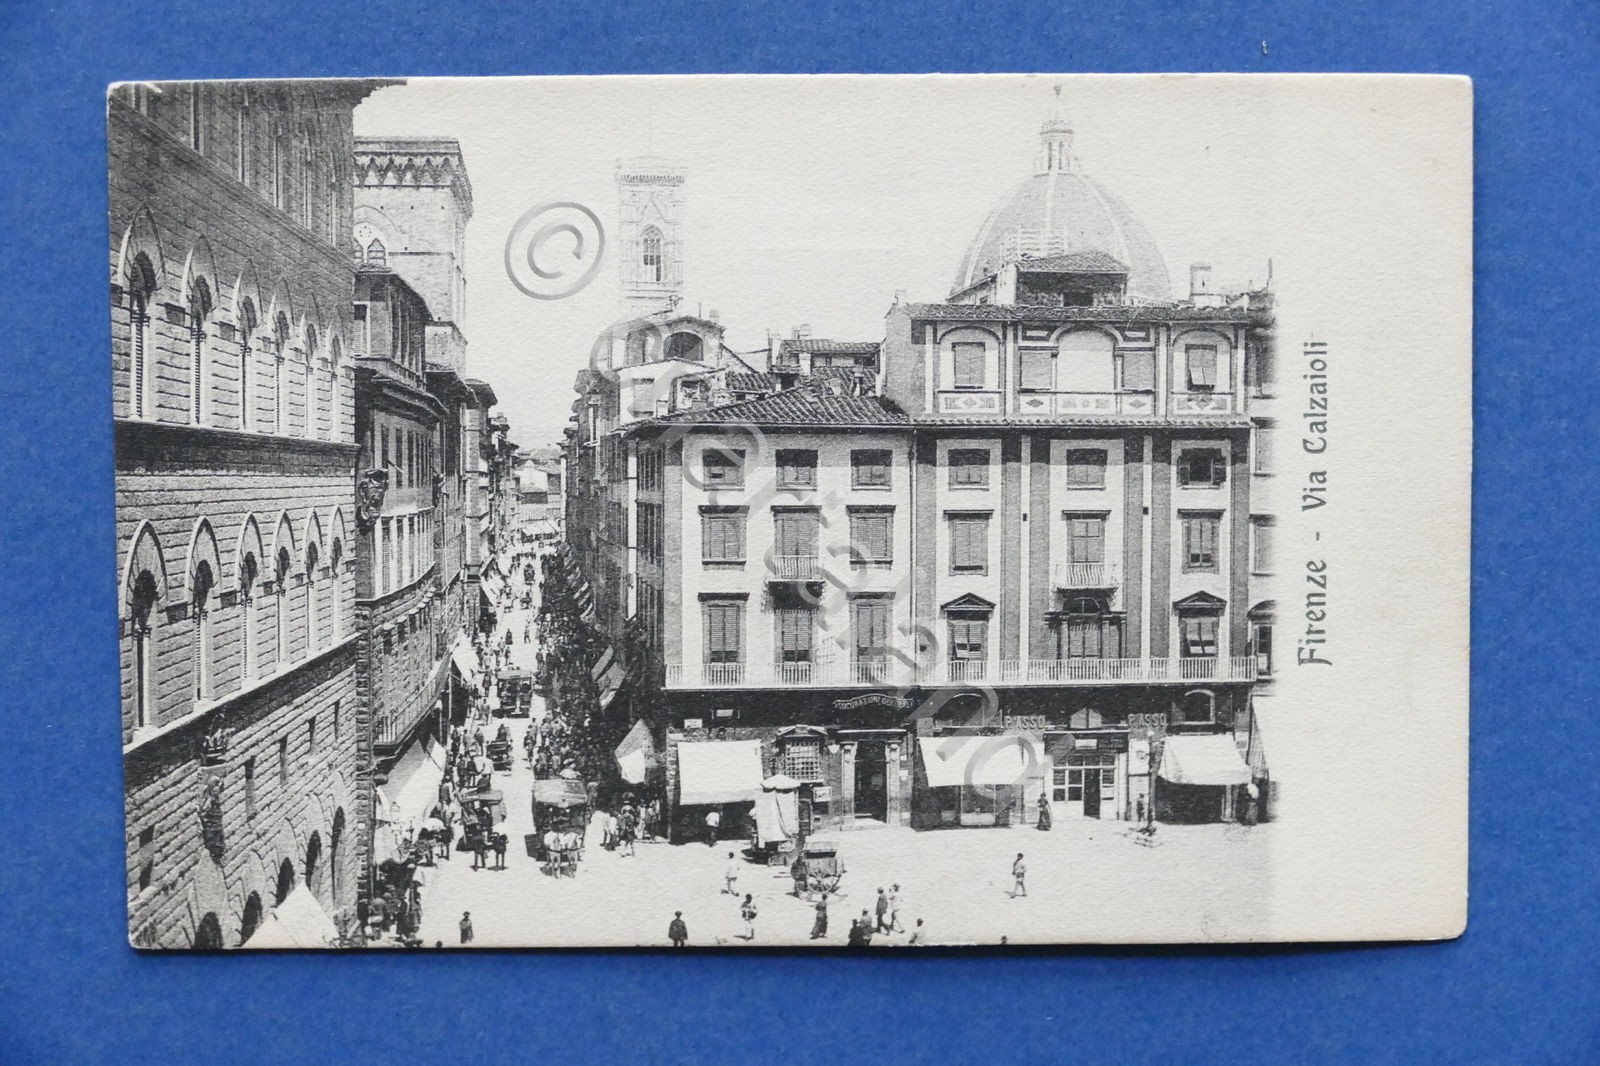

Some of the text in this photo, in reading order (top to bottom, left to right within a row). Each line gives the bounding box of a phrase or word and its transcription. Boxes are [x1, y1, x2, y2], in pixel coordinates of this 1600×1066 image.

[1303, 341, 1328, 454] Calzaioli
[1301, 470, 1327, 512] Via
[1297, 558, 1333, 666] Firenze
